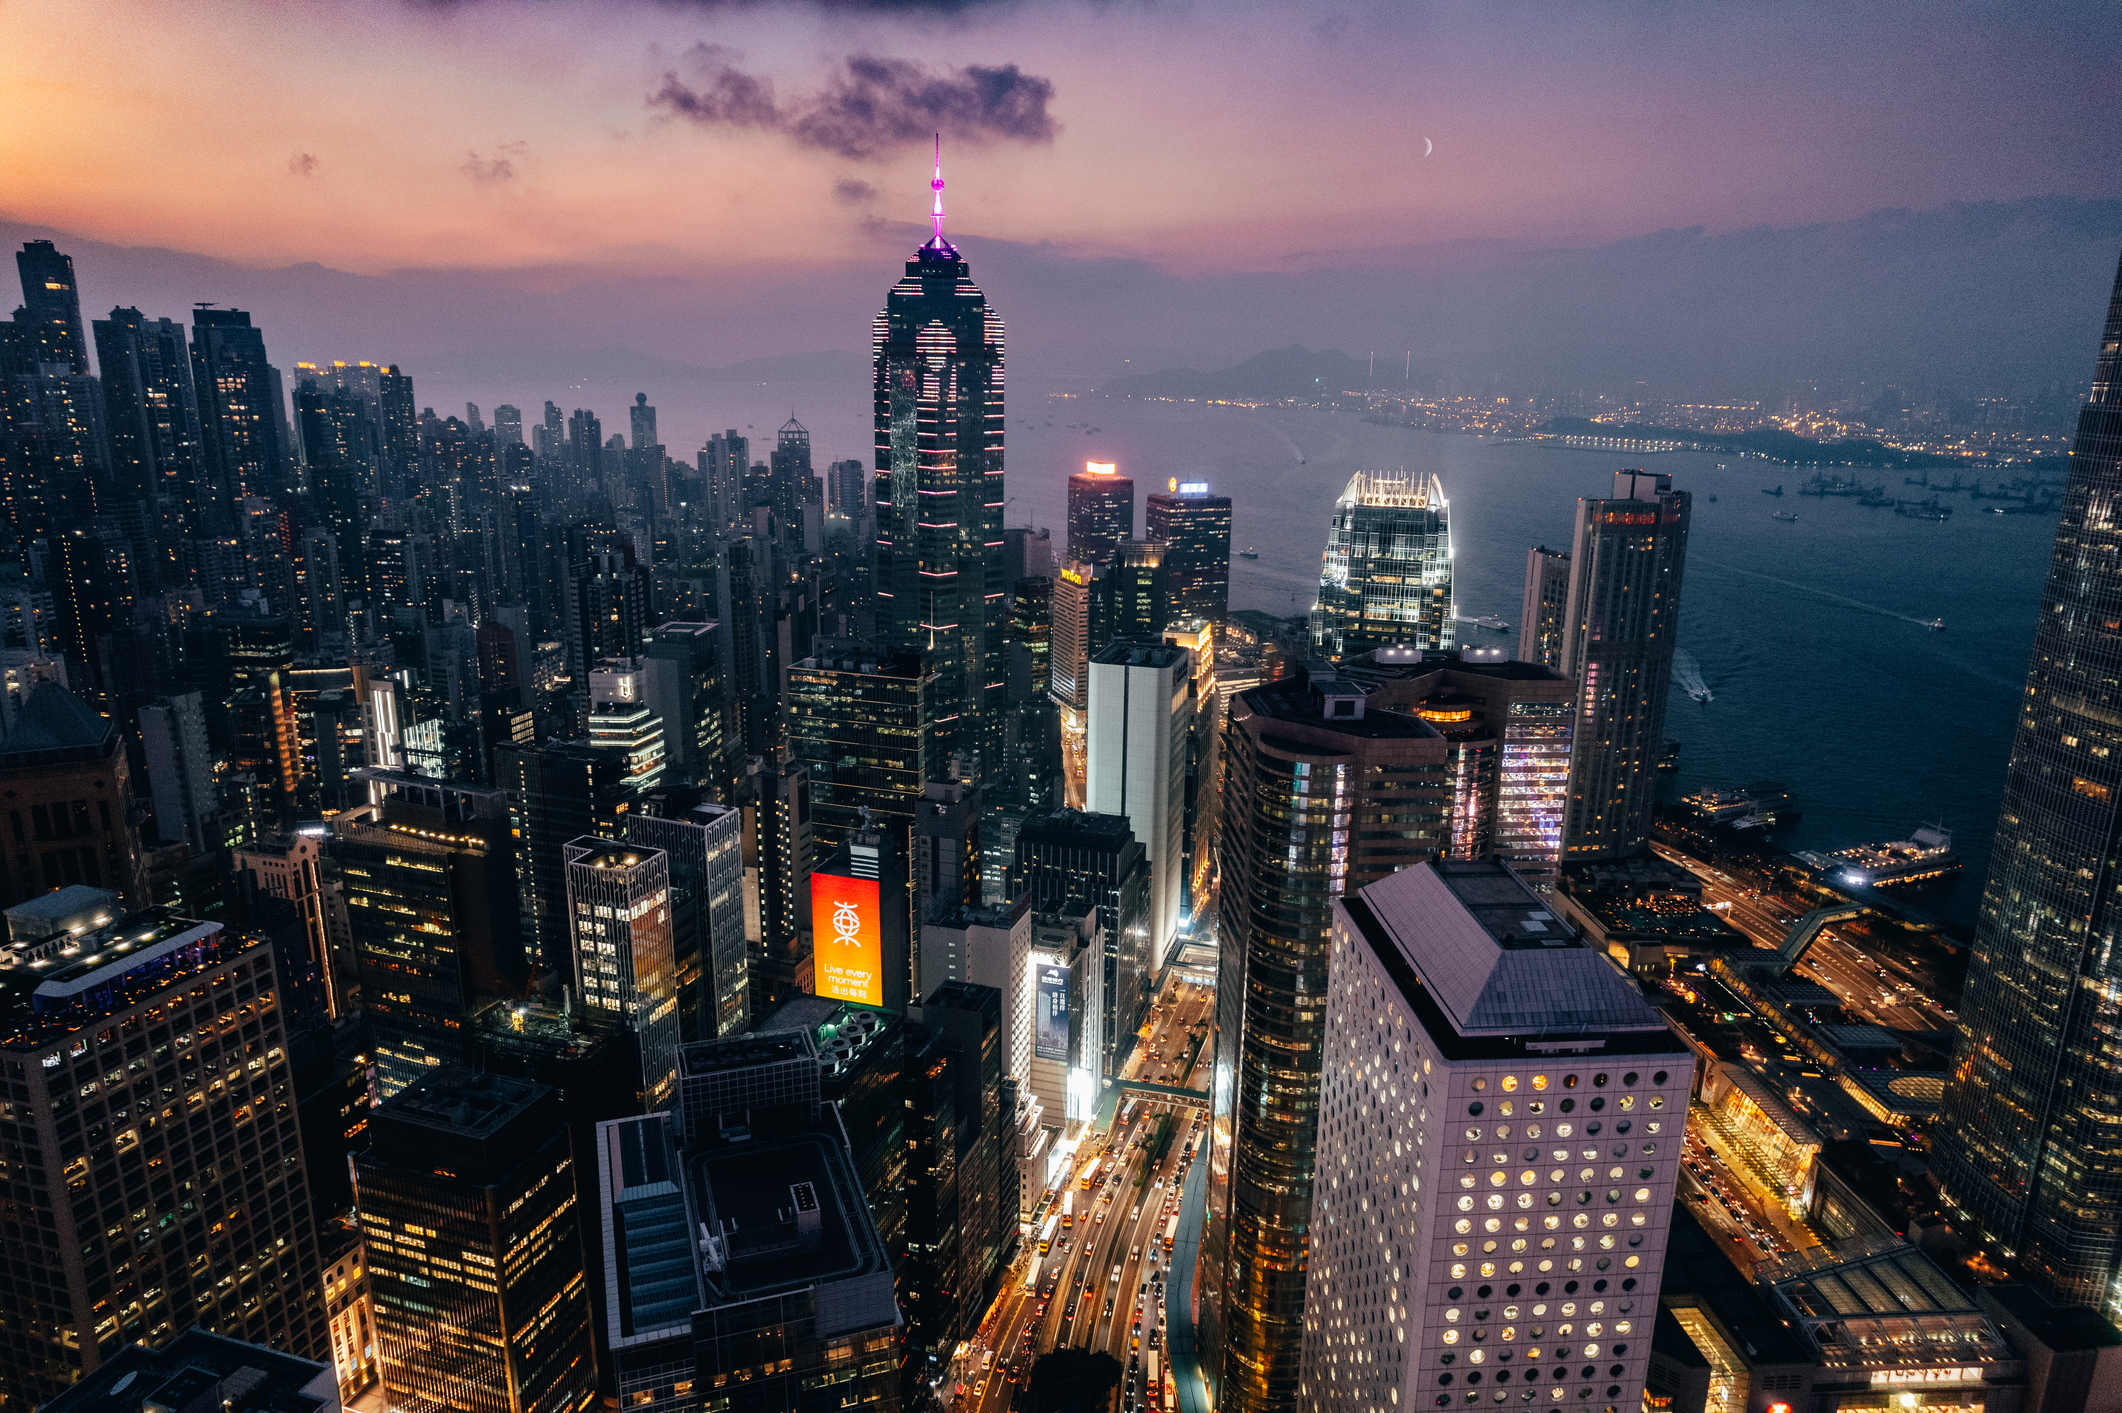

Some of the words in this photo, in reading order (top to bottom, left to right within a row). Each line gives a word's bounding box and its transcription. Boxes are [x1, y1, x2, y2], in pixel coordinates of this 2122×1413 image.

[824, 963, 843, 975] Live
[845, 969, 872, 981] every
[828, 975, 869, 988] moment
